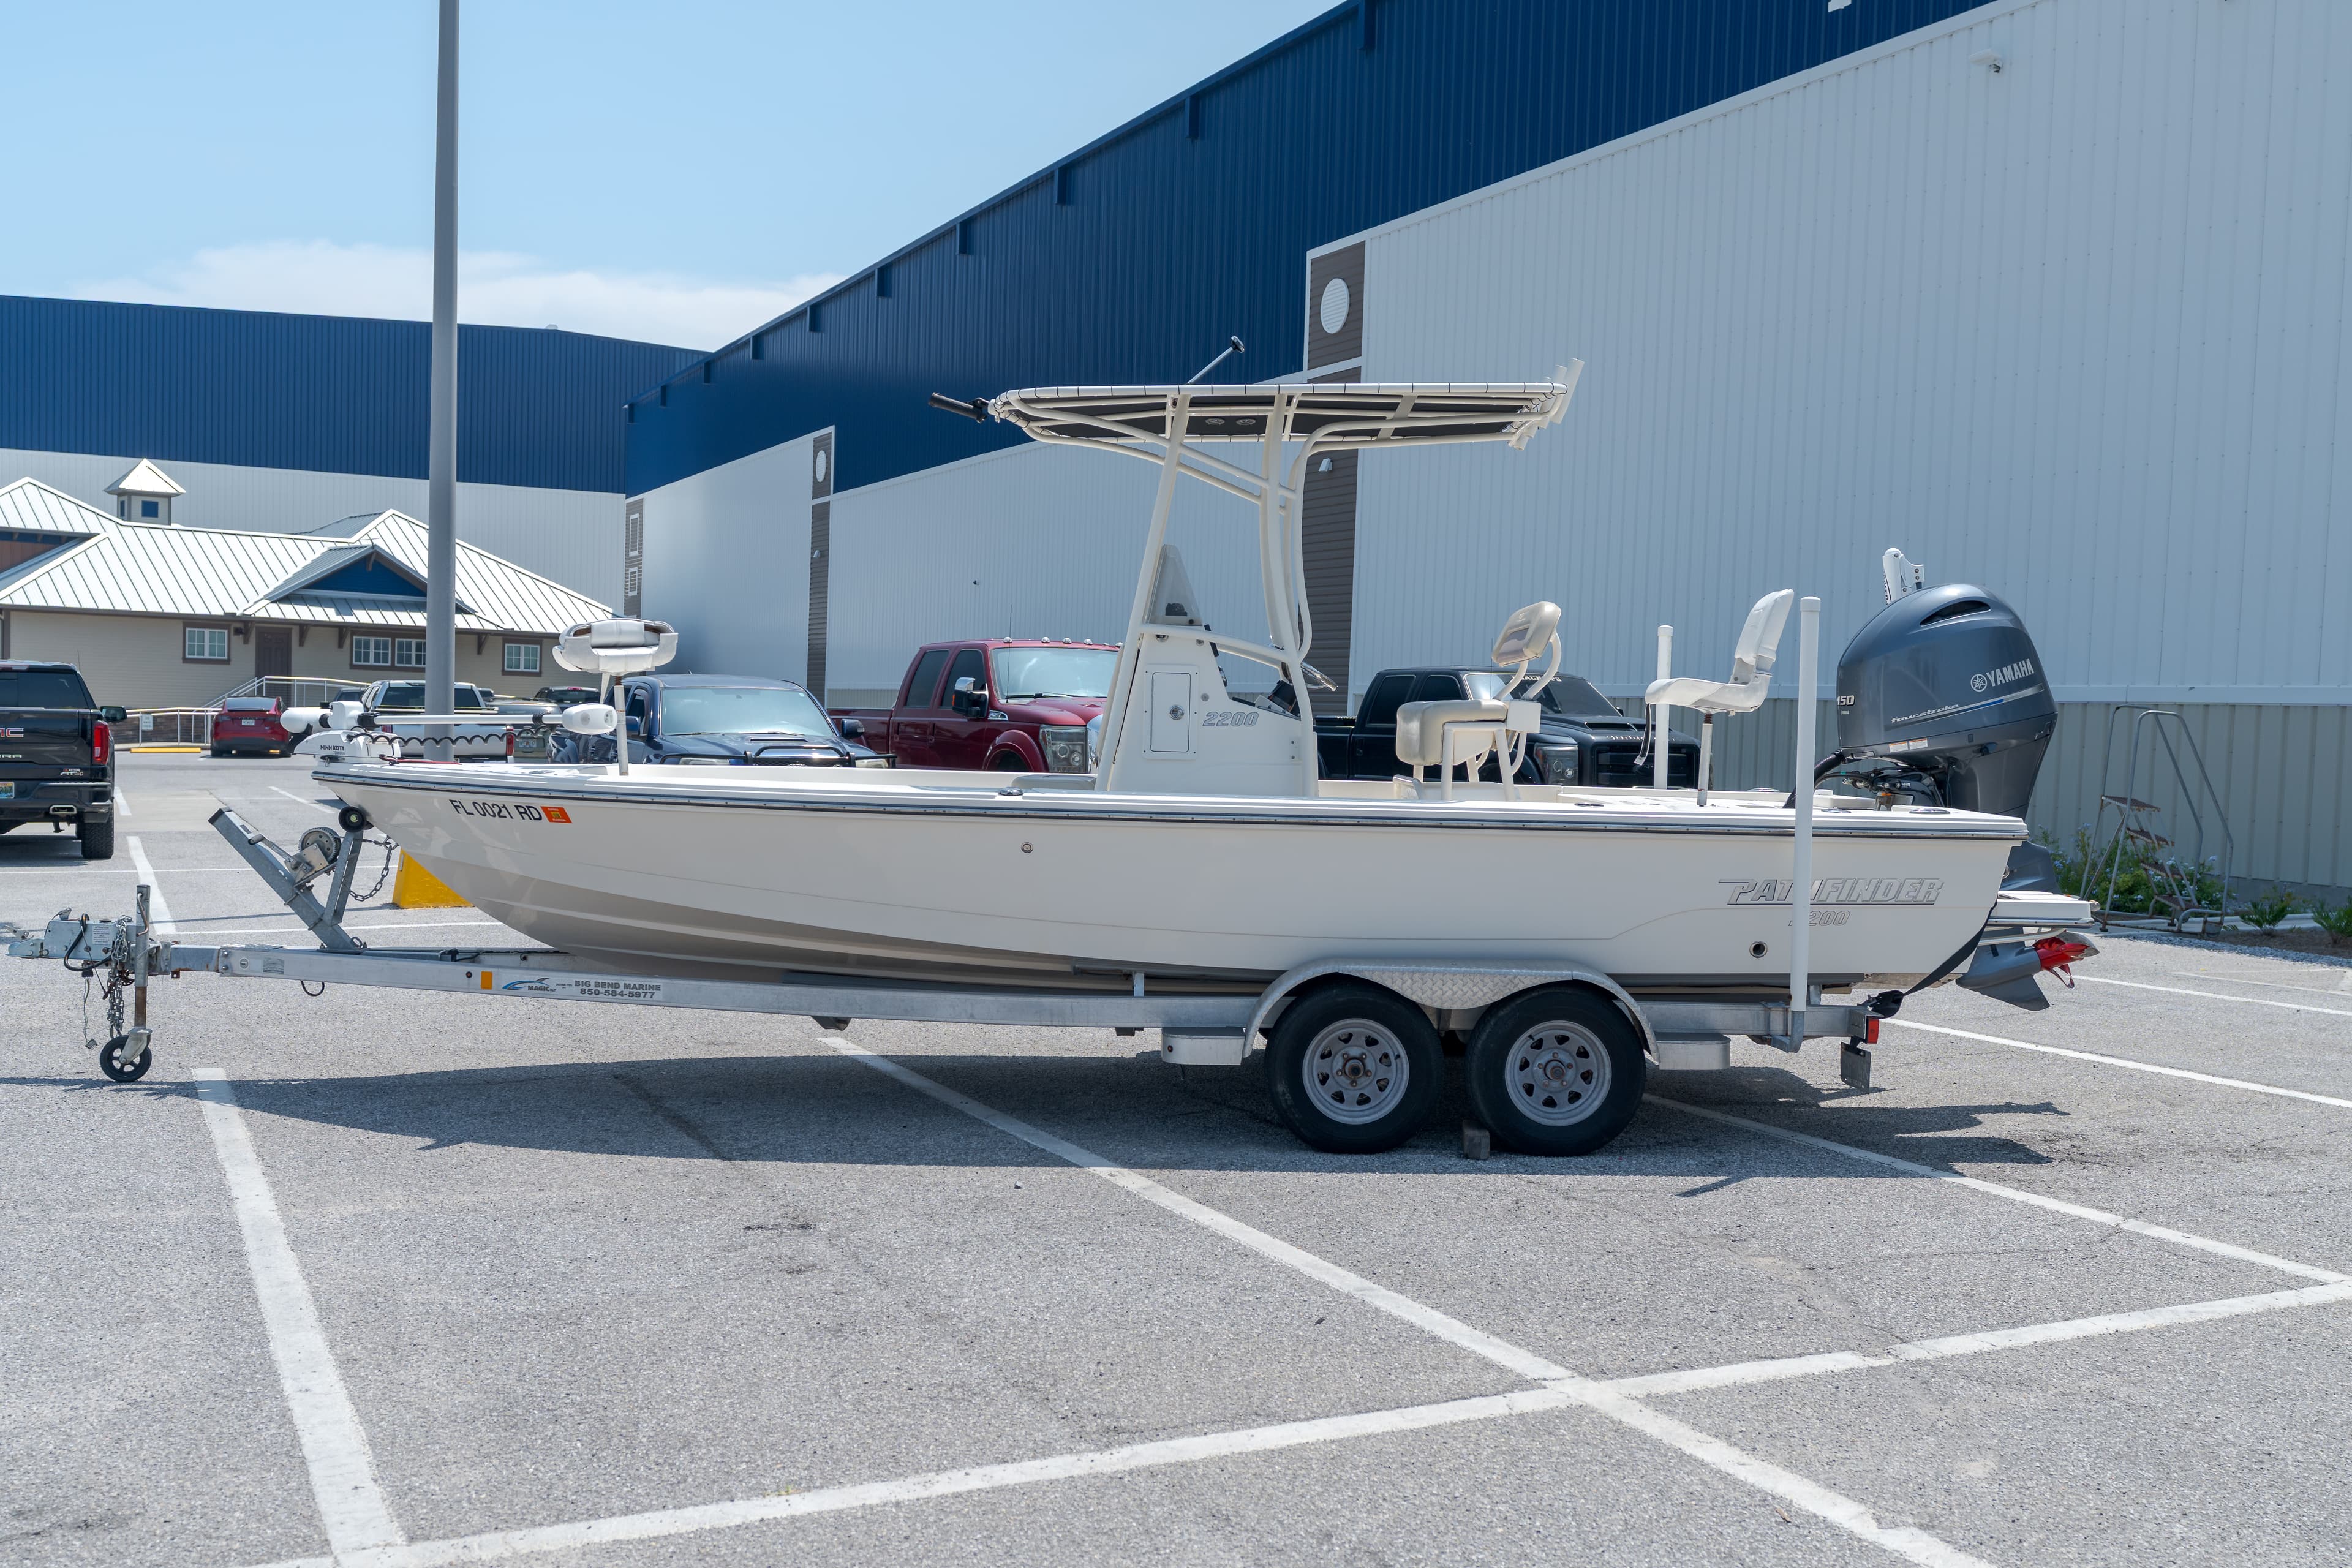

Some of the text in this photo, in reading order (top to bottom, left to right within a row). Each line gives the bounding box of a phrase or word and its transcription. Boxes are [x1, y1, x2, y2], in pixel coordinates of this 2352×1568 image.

[1986, 658, 2034, 687] YAMAHA
[1838, 695, 1855, 706] 150
[1202, 711, 1259, 726] 2200
[449, 799, 543, 821] FL 0021 RD
[1789, 910, 1850, 926] 200
[580, 988, 655, 998] 850-584-5977
